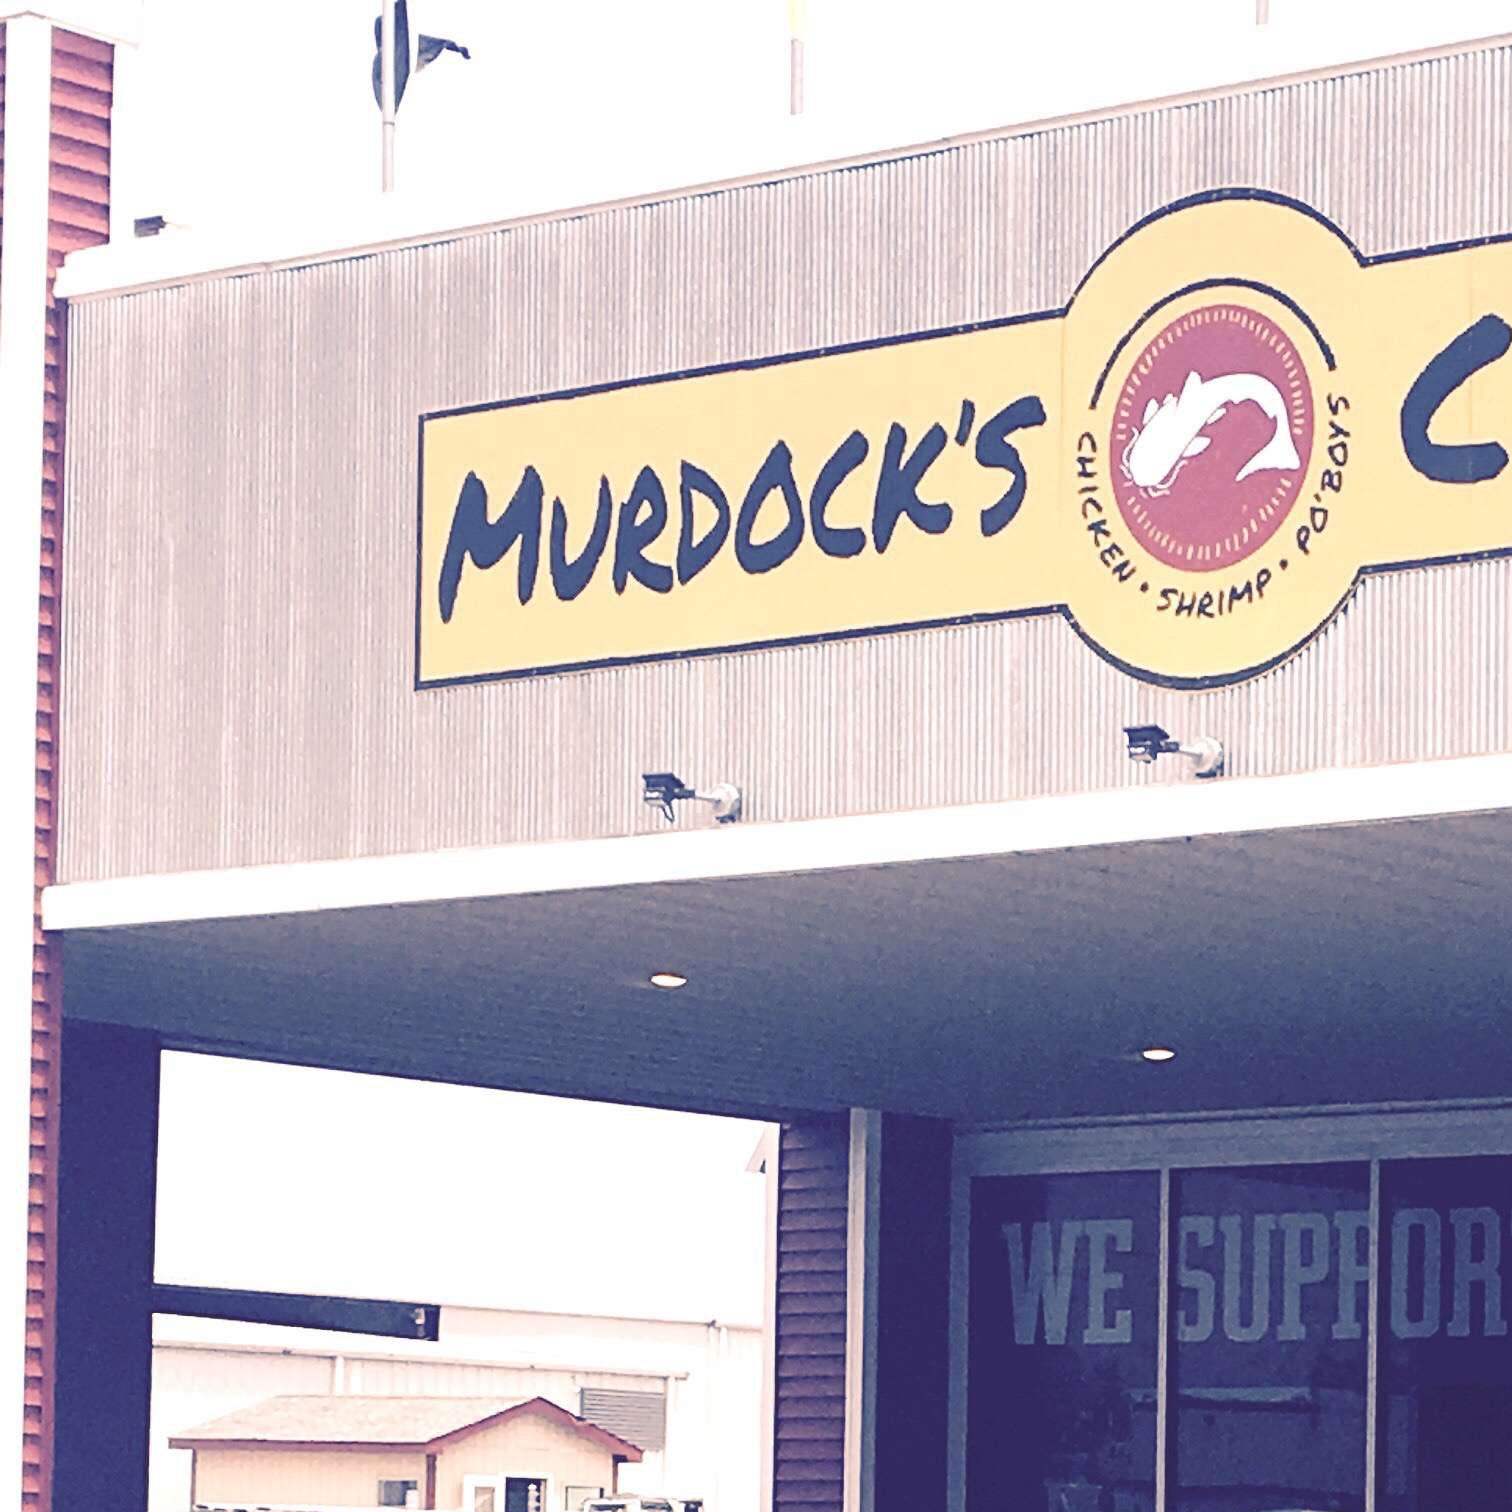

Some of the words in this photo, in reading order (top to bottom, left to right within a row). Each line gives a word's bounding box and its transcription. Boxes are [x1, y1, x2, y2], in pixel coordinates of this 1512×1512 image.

[438, 396, 1047, 624] MURDOCK'S
[1077, 431, 1135, 582] CHICKEN
[1156, 567, 1271, 618] SHRIMP
[1296, 393, 1351, 555] PO'BOYS
[1002, 1217, 1134, 1345] WE
